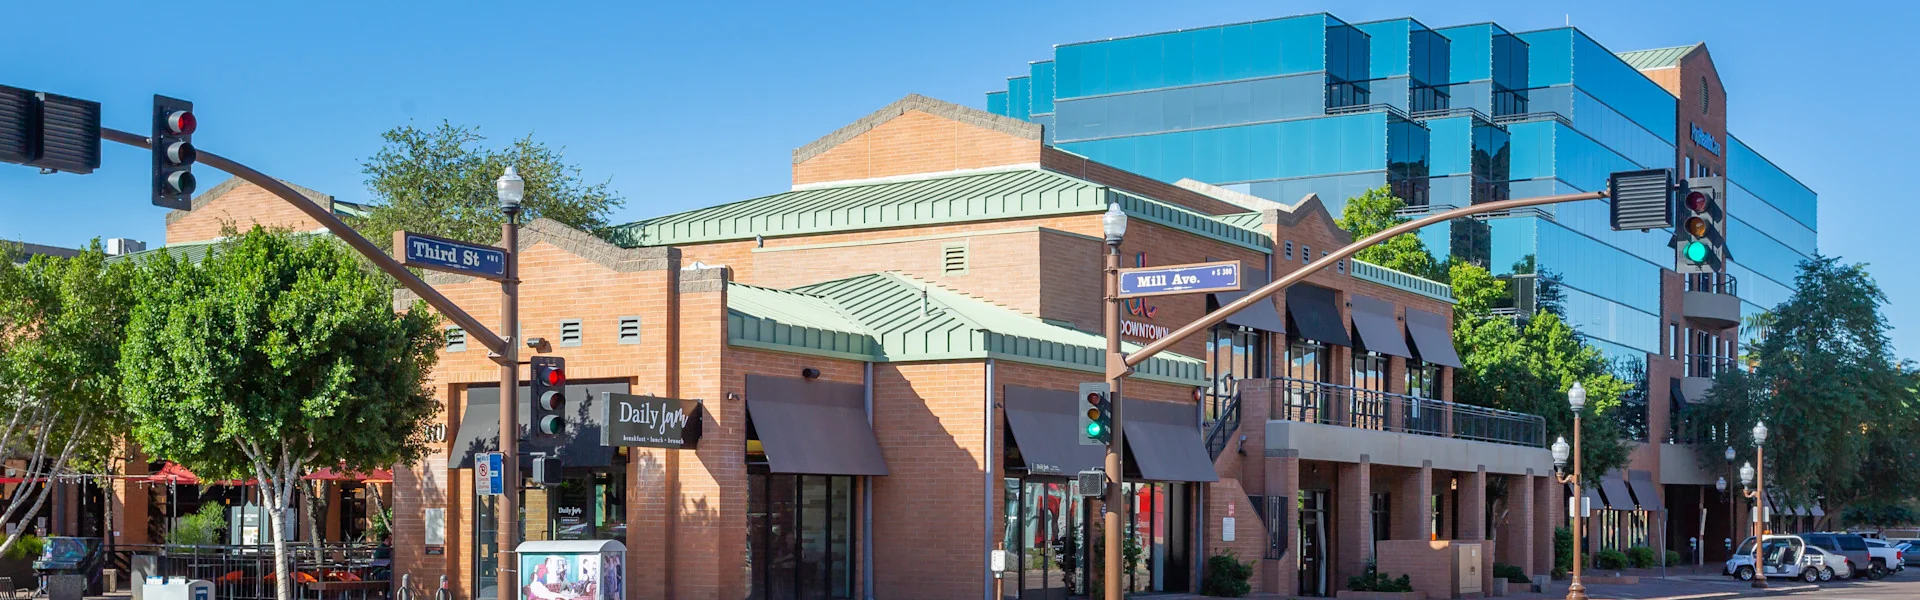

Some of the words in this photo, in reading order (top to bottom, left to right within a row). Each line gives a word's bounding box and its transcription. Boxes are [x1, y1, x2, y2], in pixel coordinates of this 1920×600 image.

[414, 241, 457, 263] Third
[463, 250, 480, 266] St
[1137, 275, 1166, 288] Mill
[1171, 273, 1201, 286] Ave.
[1120, 320, 1169, 341] DOWNTOWN
[619, 402, 659, 429] Daily
[658, 402, 689, 435] Jam
[623, 434, 646, 443] breakfast
[650, 436, 664, 444] lunch
[558, 506, 572, 516] Daily
